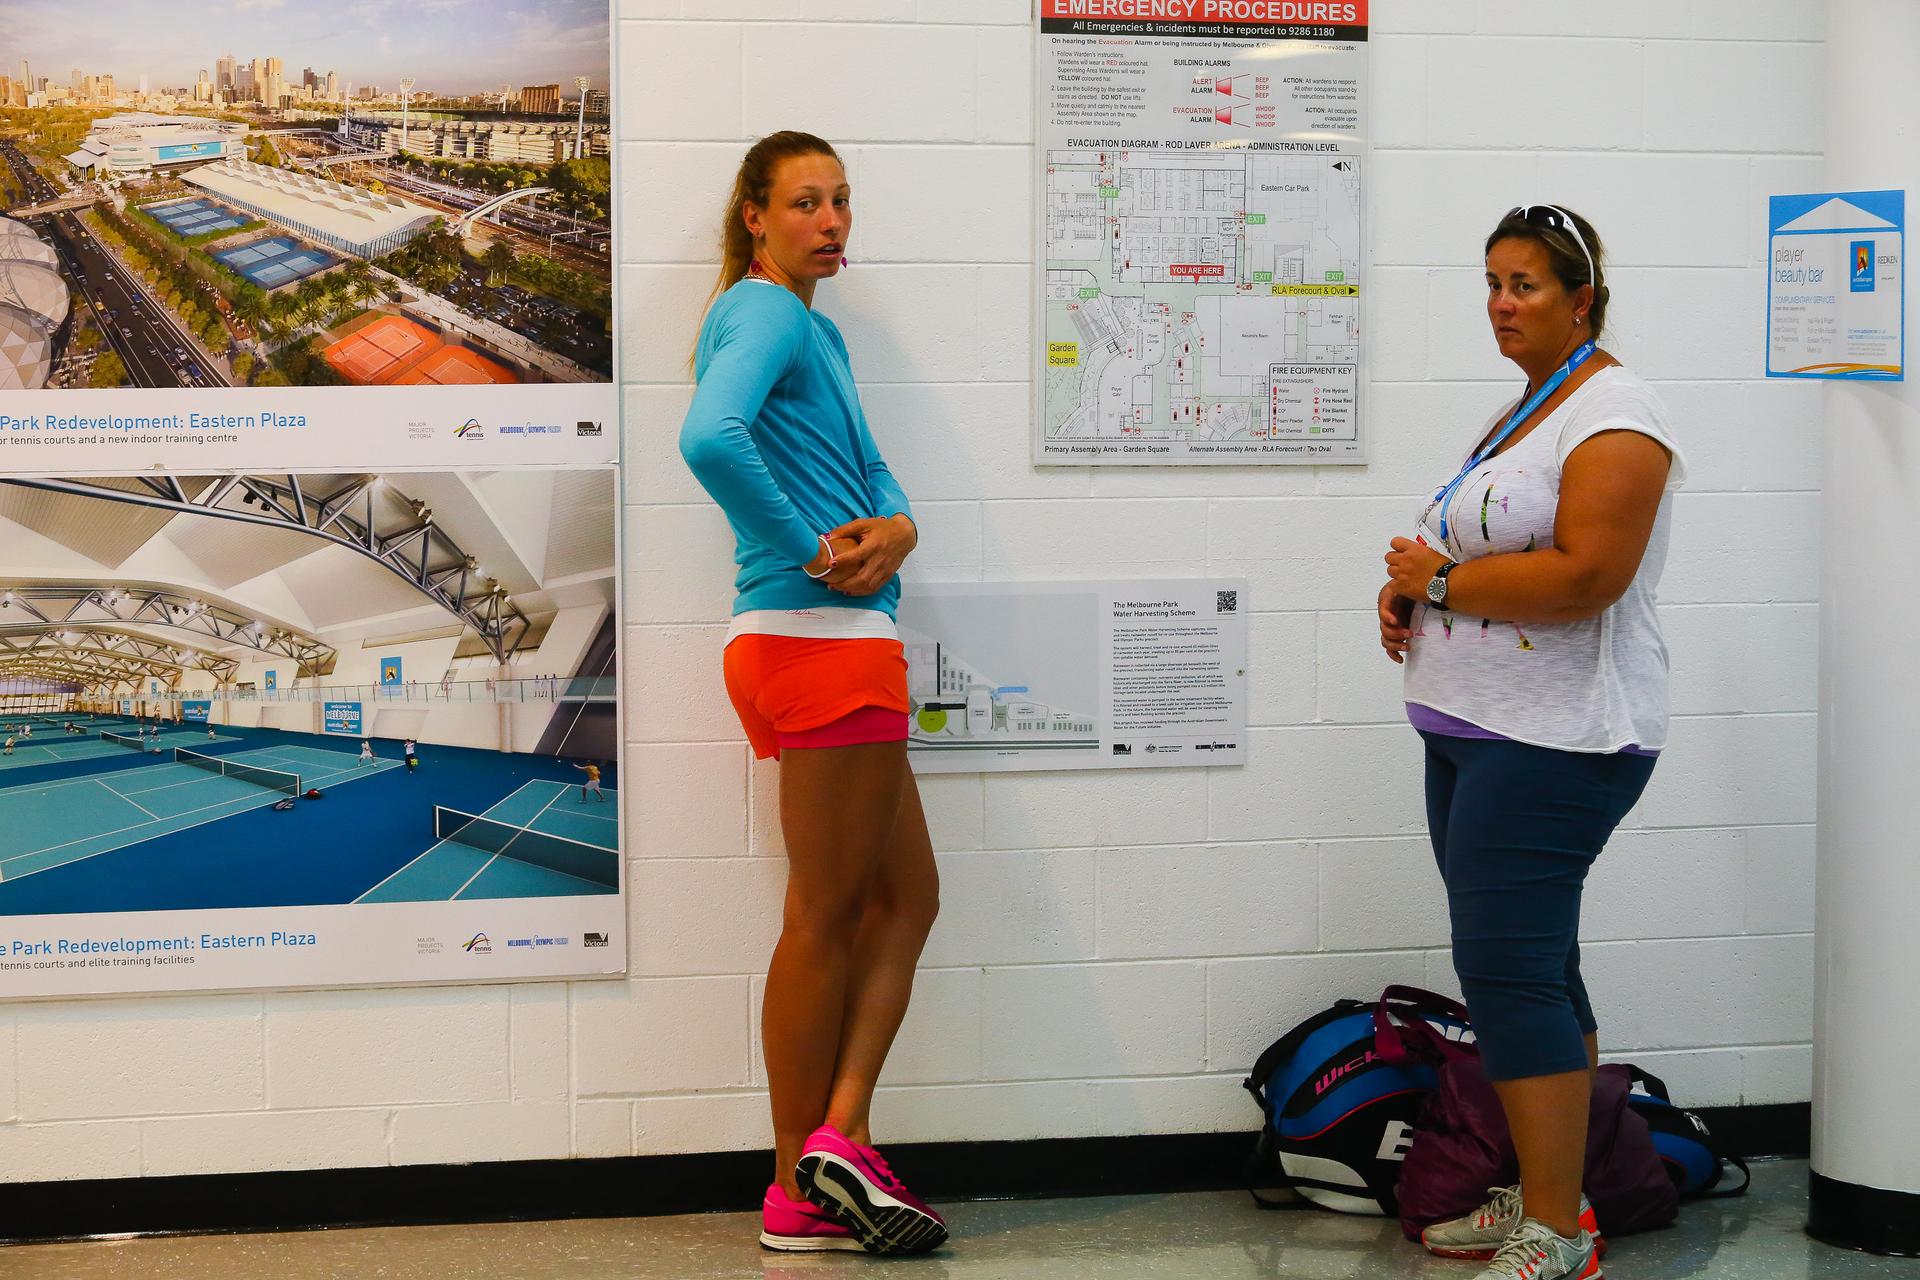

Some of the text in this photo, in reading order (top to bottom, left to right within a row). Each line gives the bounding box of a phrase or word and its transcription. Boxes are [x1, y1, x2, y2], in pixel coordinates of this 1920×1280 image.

[1054, 0, 1356, 22] EMERGENCY PROCEDURES
[1073, 22, 1335, 36] All Emergencies & incidents must be reported to 9286 1180
[1162, 40, 1179, 48] being
[1067, 139, 1339, 152] EVACUATION DIAGRAM ROD LAVER ARENA ADMINISTRATION LEVEL
[1341, 161, 1352, 171] N
[1100, 188, 1117, 196] EXIT
[1261, 184, 1310, 192] Eastern Car Park
[1247, 216, 1265, 224] EXIT
[1775, 246, 1804, 266] player
[1254, 273, 1272, 281] EXIT
[1326, 272, 1343, 280] EXIT
[1775, 266, 1824, 286] beauty bar
[1272, 287, 1347, 295] RLA Forecourt & Oval
[1049, 343, 1076, 352] Garden
[1049, 355, 1075, 365] Square
[1290, 367, 1336, 375] EQUIPMENT
[1337, 367, 1352, 375] KEY
[0, 412, 306, 432] Park Redevelopment: Eastern Plaza
[11, 436, 41, 444] tennis
[43, 436, 75, 444] courts
[78, 434, 97, 444] and
[99, 436, 105, 444] a
[131, 434, 162, 443] indoor
[165, 434, 204, 444] training
[206, 434, 238, 442] centre
[1044, 446, 1069, 454] Primary
[1070, 446, 1101, 454] Assembly
[1147, 446, 1170, 454] Square
[1275, 445, 1303, 453] Forecourt
[1134, 610, 1168, 618] Harvesting
[12, 931, 316, 955] Park Redevelopment: Eastern Plaza
[0, 955, 195, 970] tennis courts and elite training facilities
